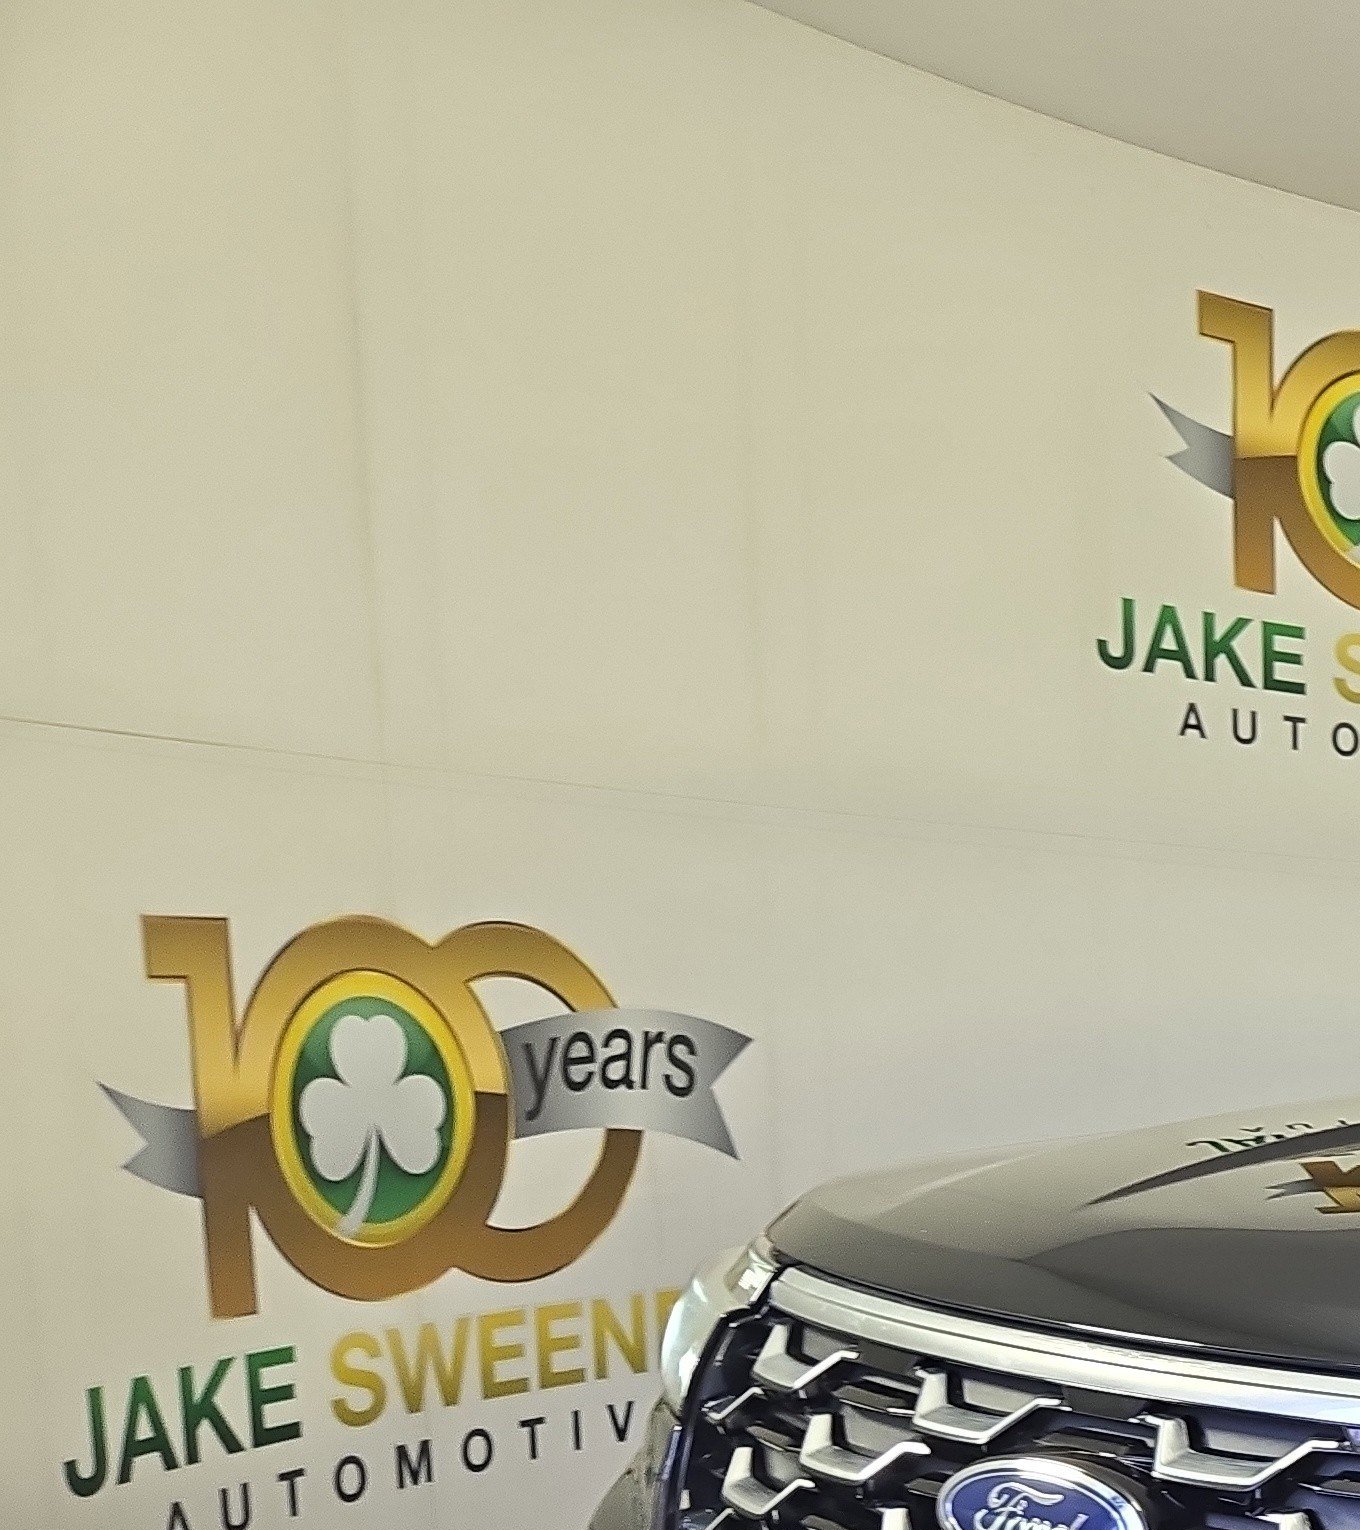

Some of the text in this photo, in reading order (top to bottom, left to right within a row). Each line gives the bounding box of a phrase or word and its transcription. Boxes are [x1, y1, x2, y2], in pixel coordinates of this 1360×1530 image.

[1096, 597, 1308, 696] JAKE
[140, 914, 697, 1319] 100 years
[62, 1286, 683, 1498] JAKE SWEEN
